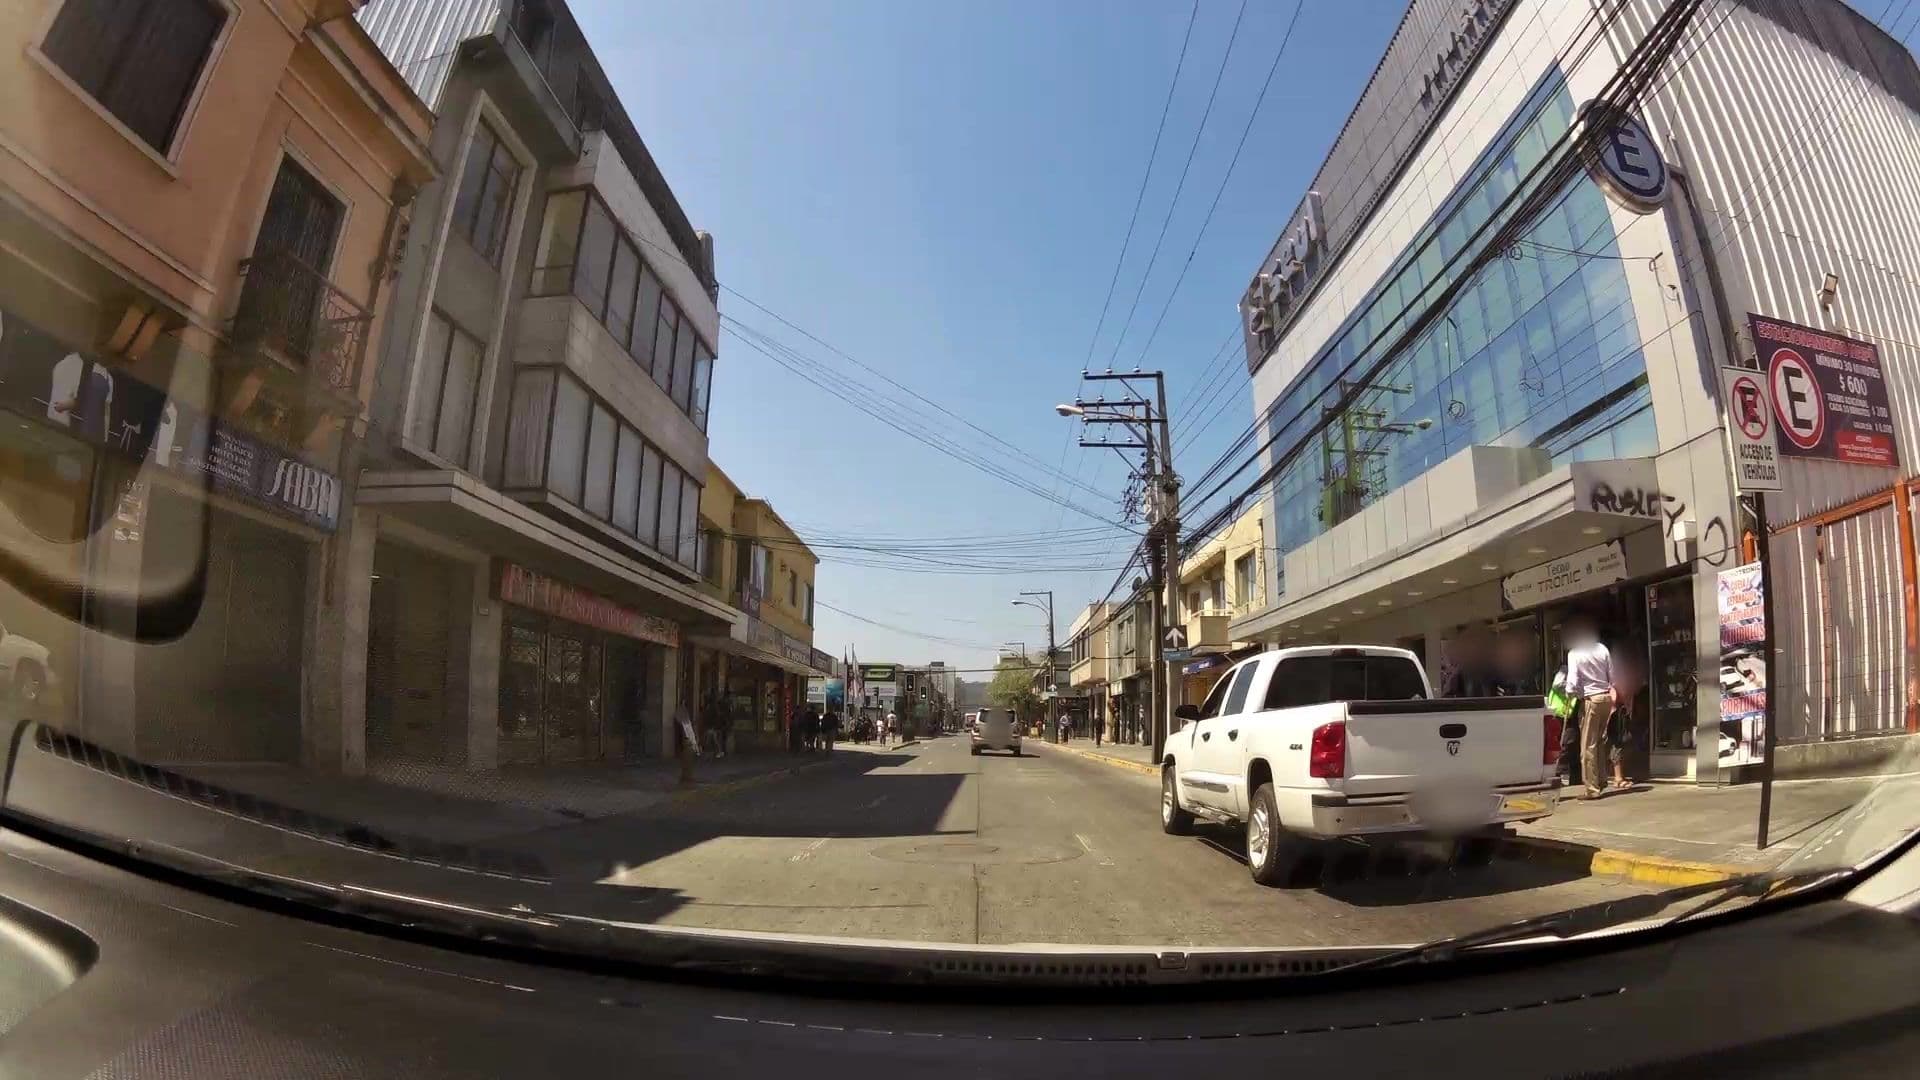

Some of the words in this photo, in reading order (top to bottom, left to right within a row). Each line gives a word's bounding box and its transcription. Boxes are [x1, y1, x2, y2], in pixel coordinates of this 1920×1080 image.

[1609, 128, 1650, 178] E
[1783, 366, 1813, 430] E
[1847, 376, 1867, 396] 600
[1740, 444, 1763, 460] ACCESO
[1764, 445, 1773, 461] DE
